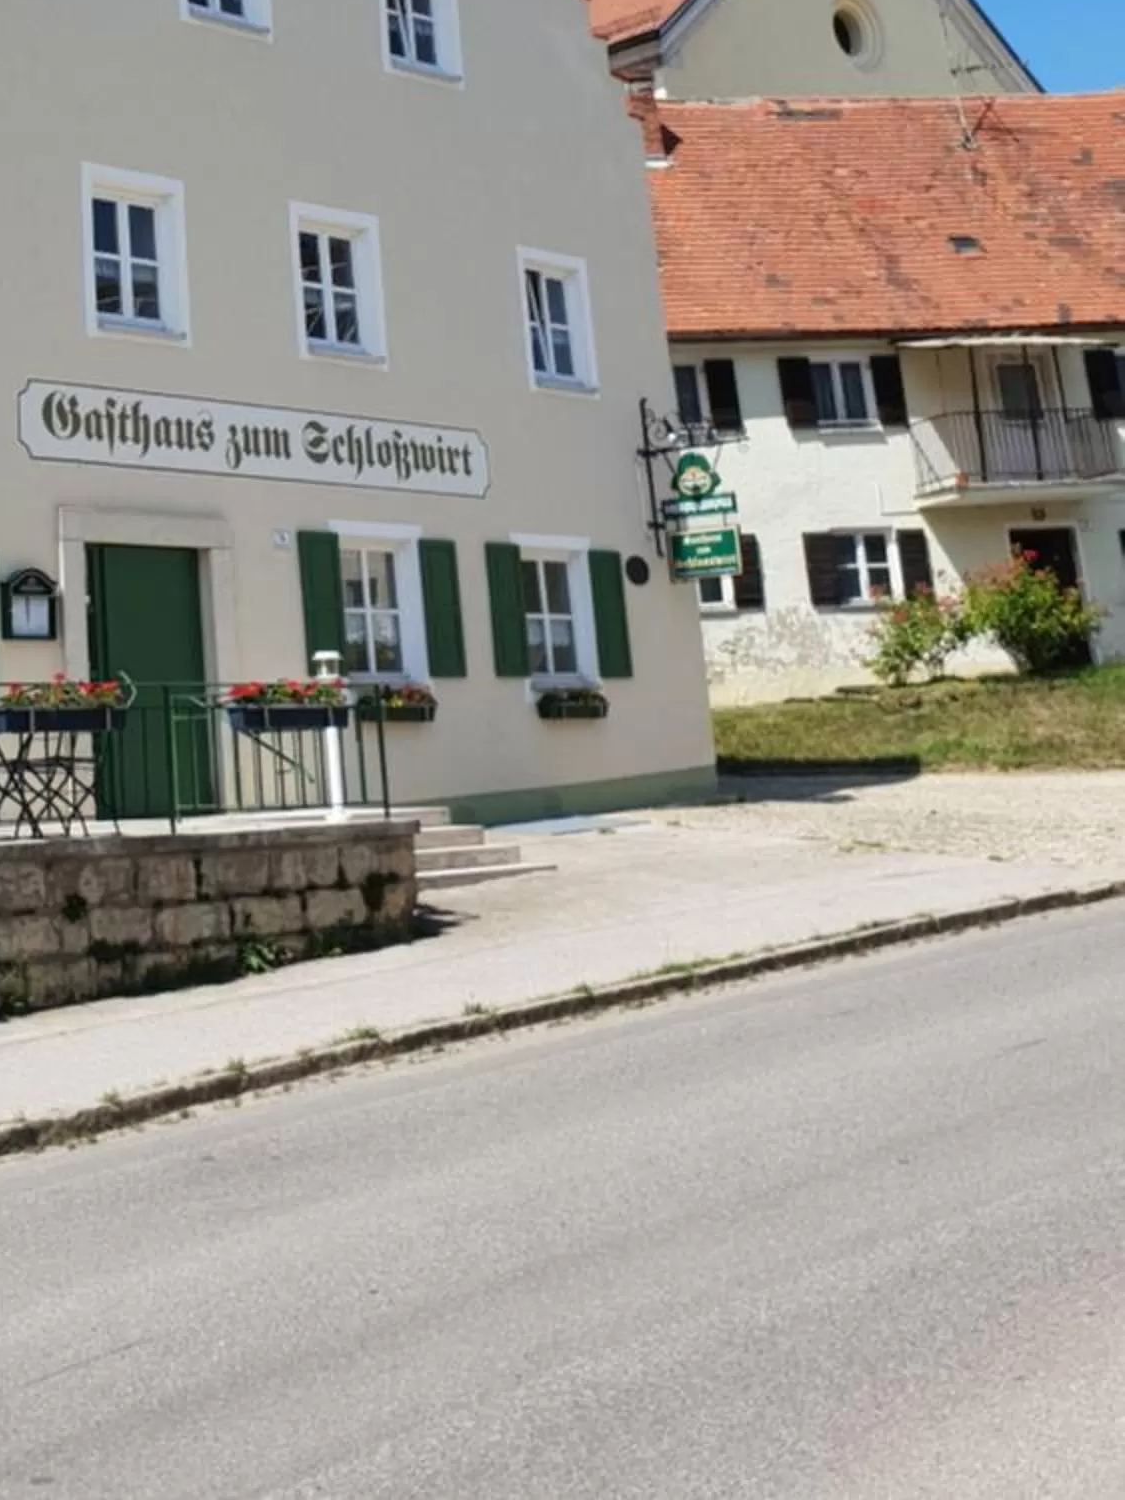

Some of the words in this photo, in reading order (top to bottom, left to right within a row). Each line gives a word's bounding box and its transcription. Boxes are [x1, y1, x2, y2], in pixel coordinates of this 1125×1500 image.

[41, 390, 215, 458] Gasthaus
[225, 424, 292, 470] zum
[302, 420, 473, 480] Schloßwirt
